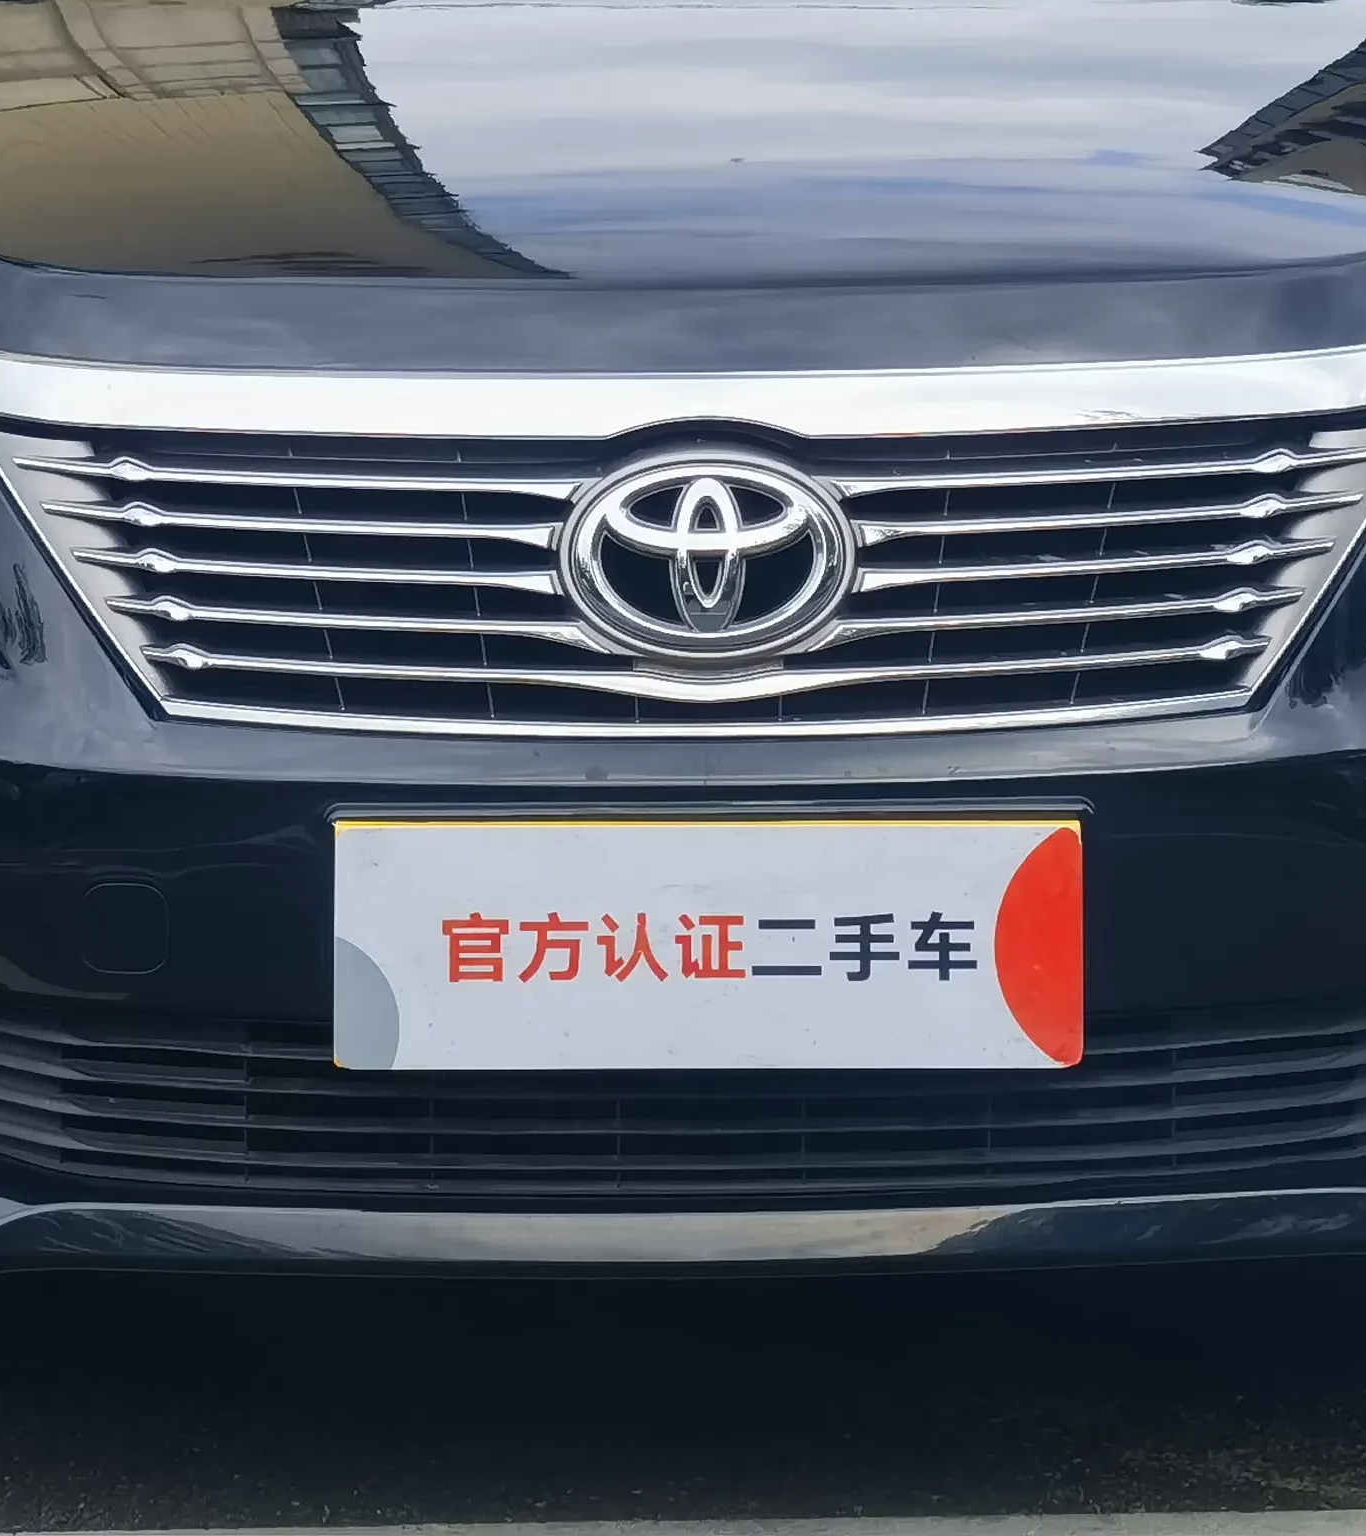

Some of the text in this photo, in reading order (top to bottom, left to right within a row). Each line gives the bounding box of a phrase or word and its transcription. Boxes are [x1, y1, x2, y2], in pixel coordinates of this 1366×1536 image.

[441, 912, 978, 983] 官方认证二手车
